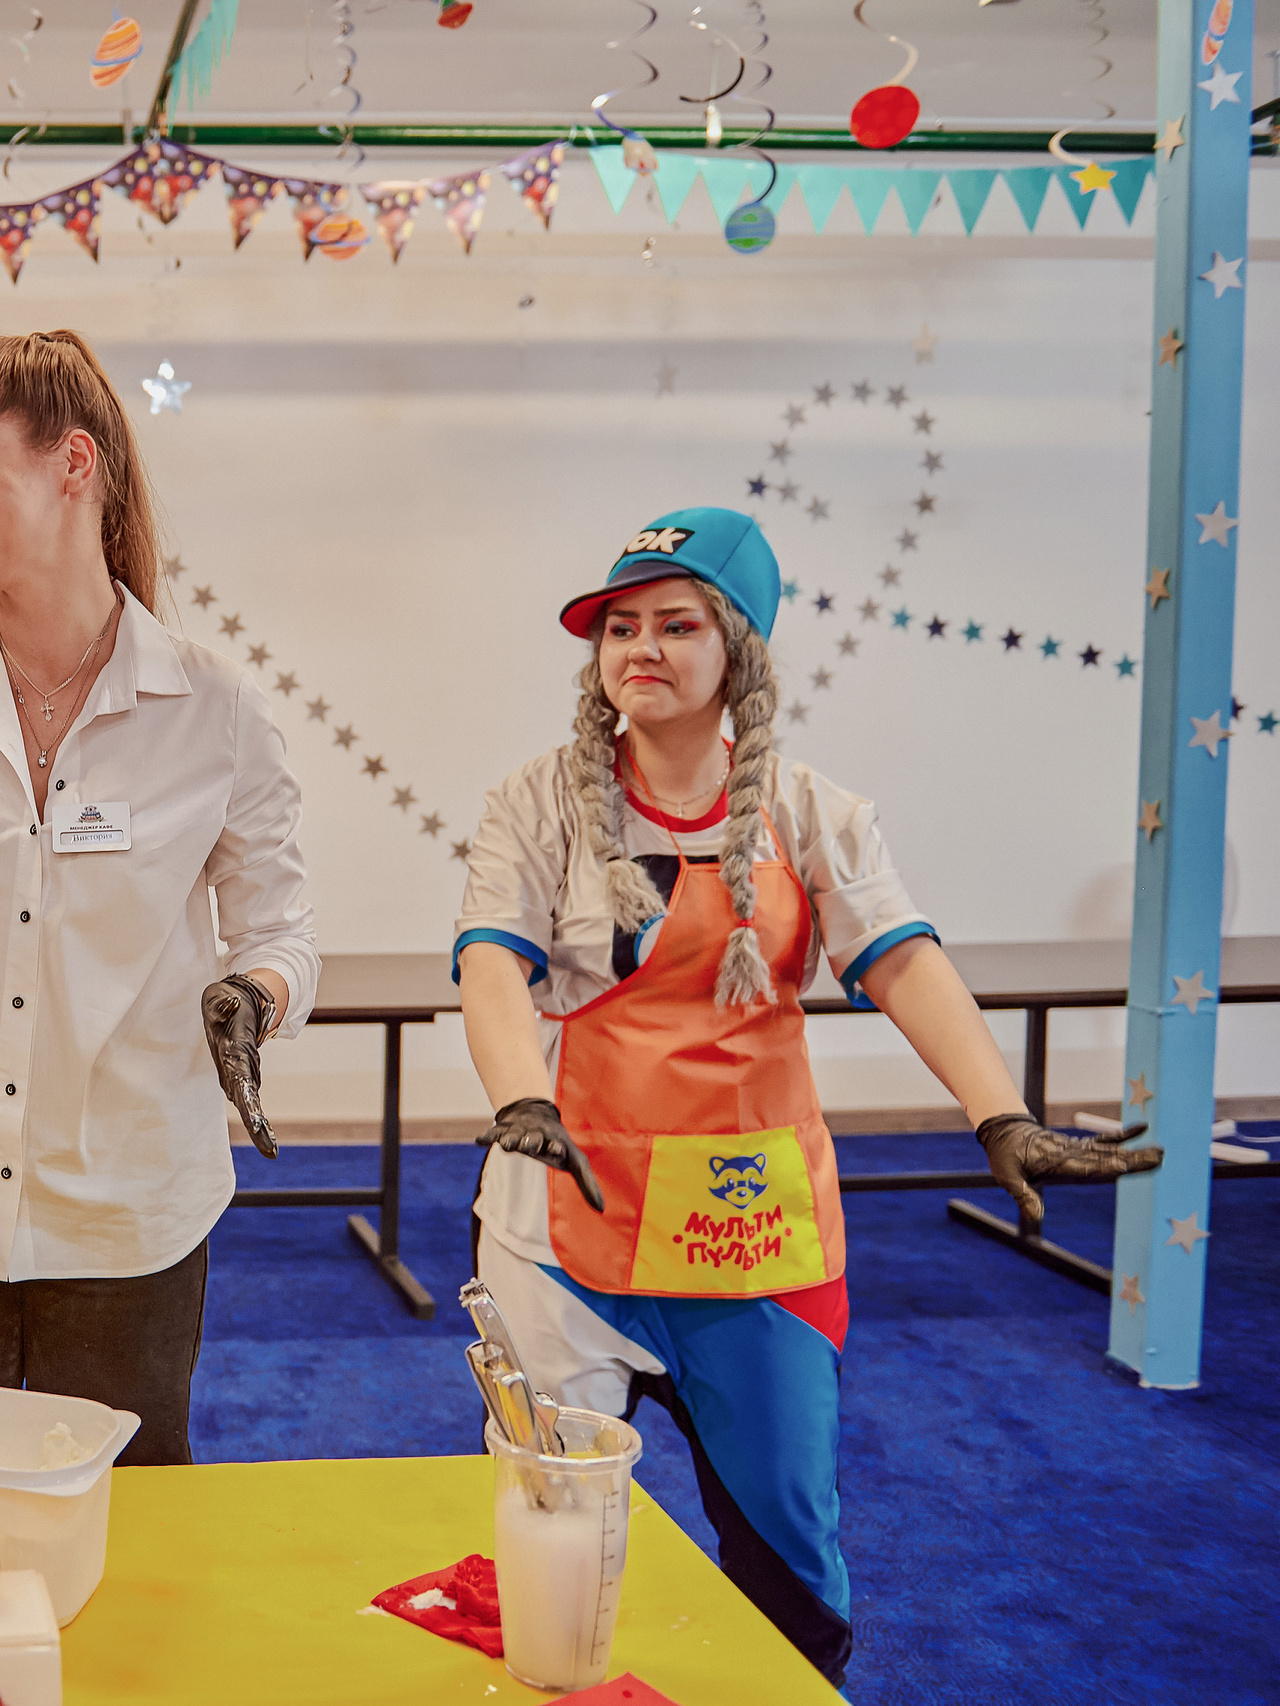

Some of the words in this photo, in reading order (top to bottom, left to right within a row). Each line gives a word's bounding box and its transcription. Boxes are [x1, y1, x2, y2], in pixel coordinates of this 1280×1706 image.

[72, 833, 113, 842] Виктория
[684, 1204, 783, 1243] МУЛЬТИ
[687, 1235, 781, 1271] ПУЛЬТИ
